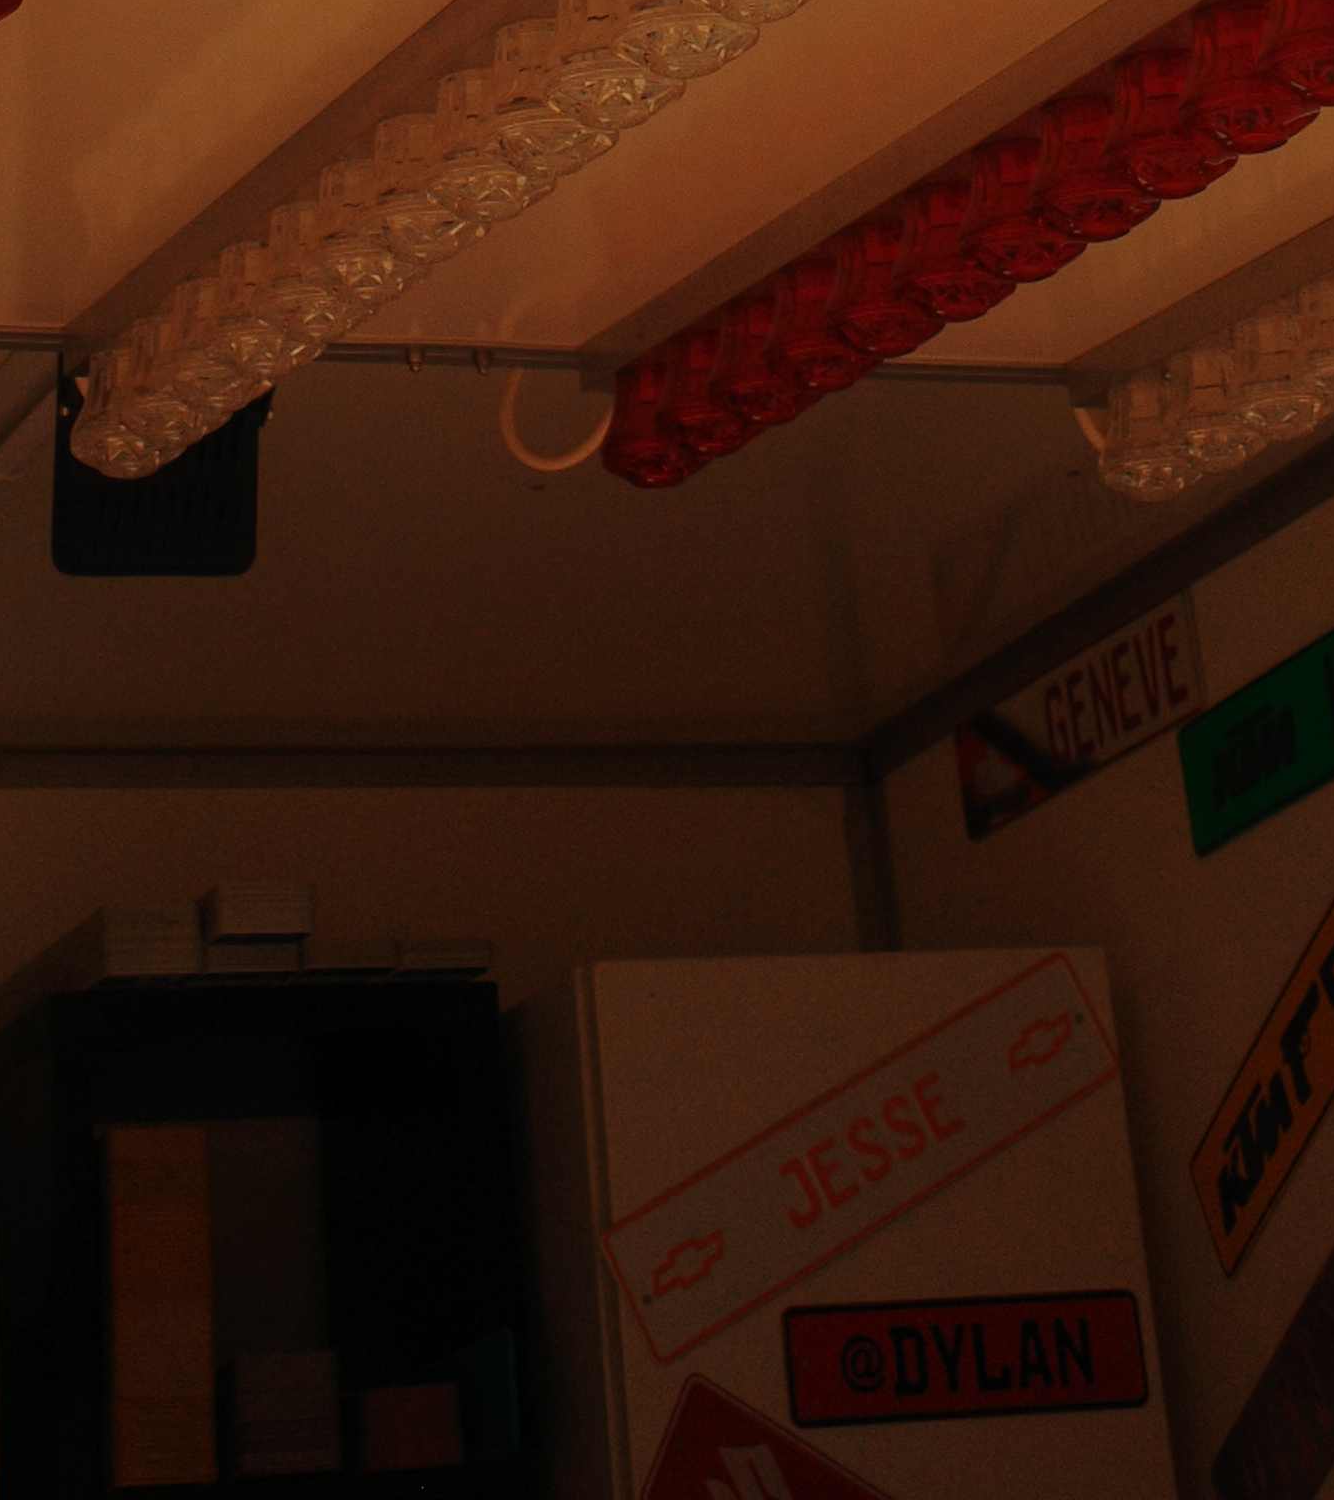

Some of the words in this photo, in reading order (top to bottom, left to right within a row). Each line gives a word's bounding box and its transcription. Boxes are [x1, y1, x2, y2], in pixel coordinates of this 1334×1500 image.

[1043, 612, 1188, 762] GENEVE
[778, 1071, 967, 1230] JESSE
[1217, 1069, 1292, 1236] KTM
[838, 1316, 1095, 1398] @DYLAN
